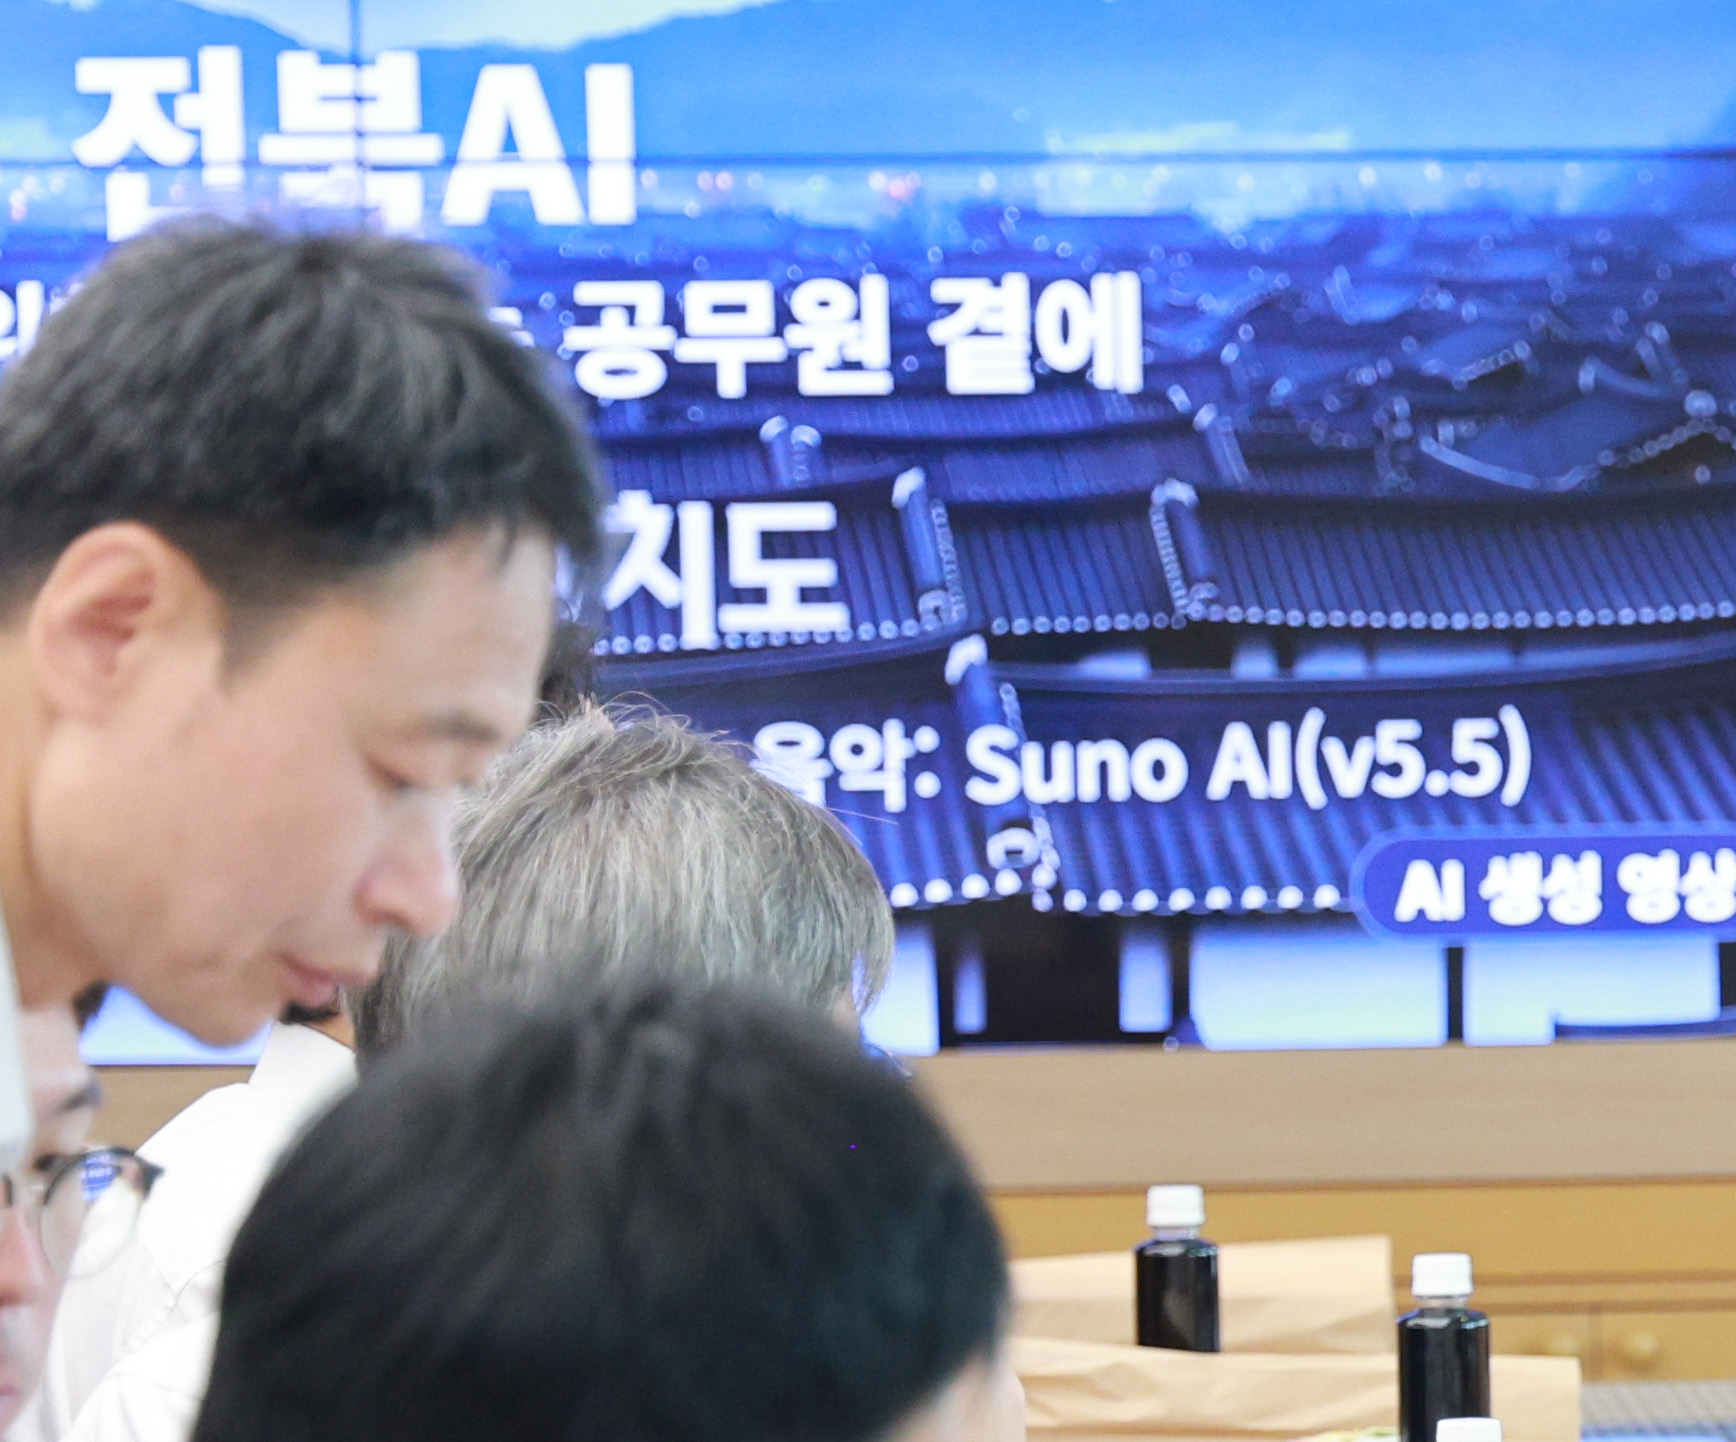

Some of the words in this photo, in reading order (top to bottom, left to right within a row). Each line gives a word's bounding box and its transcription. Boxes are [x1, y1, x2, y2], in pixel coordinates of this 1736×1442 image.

[72, 45, 636, 242] 전북AI
[563, 273, 895, 401] 공무원
[927, 269, 1144, 397] 곁에
[600, 490, 851, 652] 치도
[964, 723, 1190, 806] Suno
[1205, 704, 1533, 811] AI(v5.5)
[1394, 858, 1466, 923] AI
[1478, 850, 1603, 926] 생성
